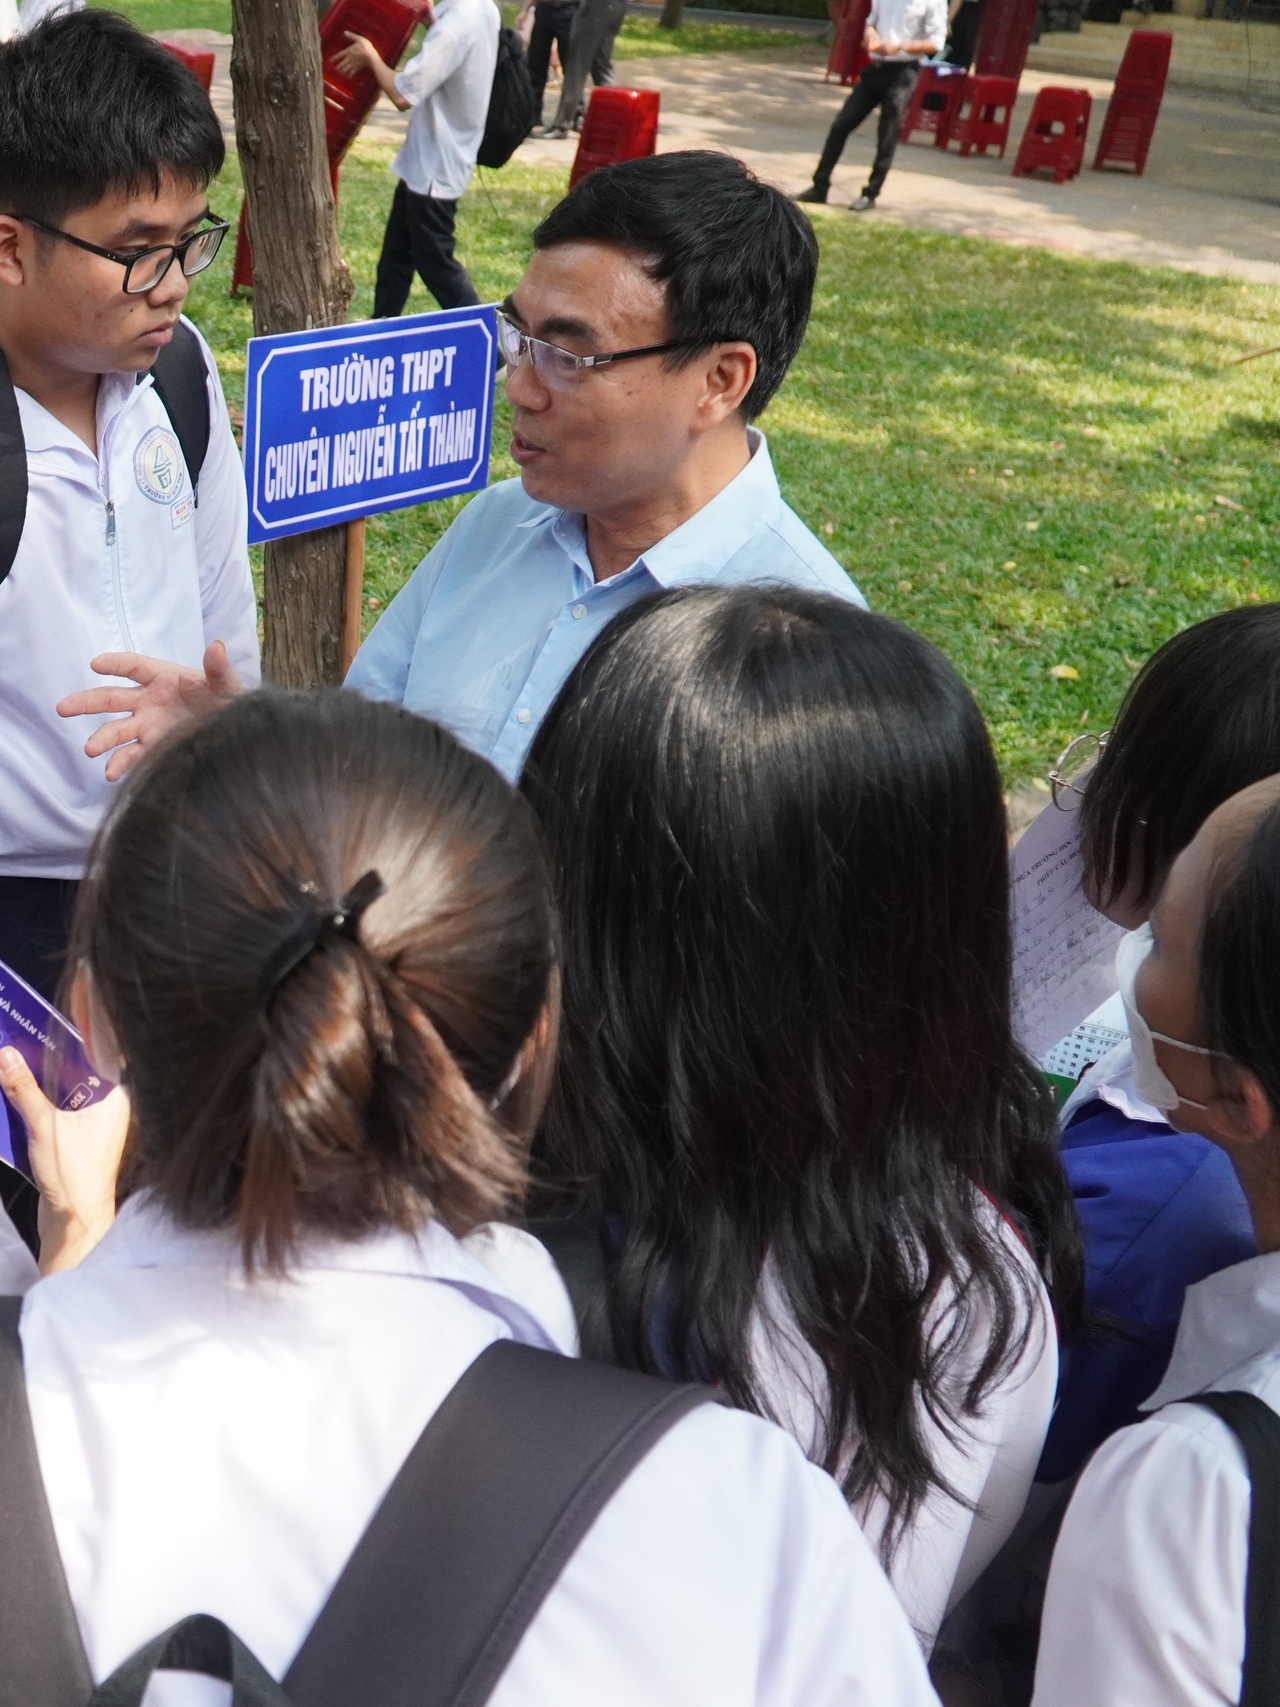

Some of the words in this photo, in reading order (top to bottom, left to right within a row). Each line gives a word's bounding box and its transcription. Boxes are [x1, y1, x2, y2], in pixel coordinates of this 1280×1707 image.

[300, 353, 395, 412] TRƯỜNG
[401, 346, 457, 394] THPT
[264, 427, 330, 503] CHUYÊN
[332, 404, 396, 488] NGUYỄN
[399, 401, 426, 474] TẤT
[428, 402, 477, 467] THÀNH
[10, 1009, 37, 1035] NHÂN
[37, 1031, 56, 1051] VĂN
